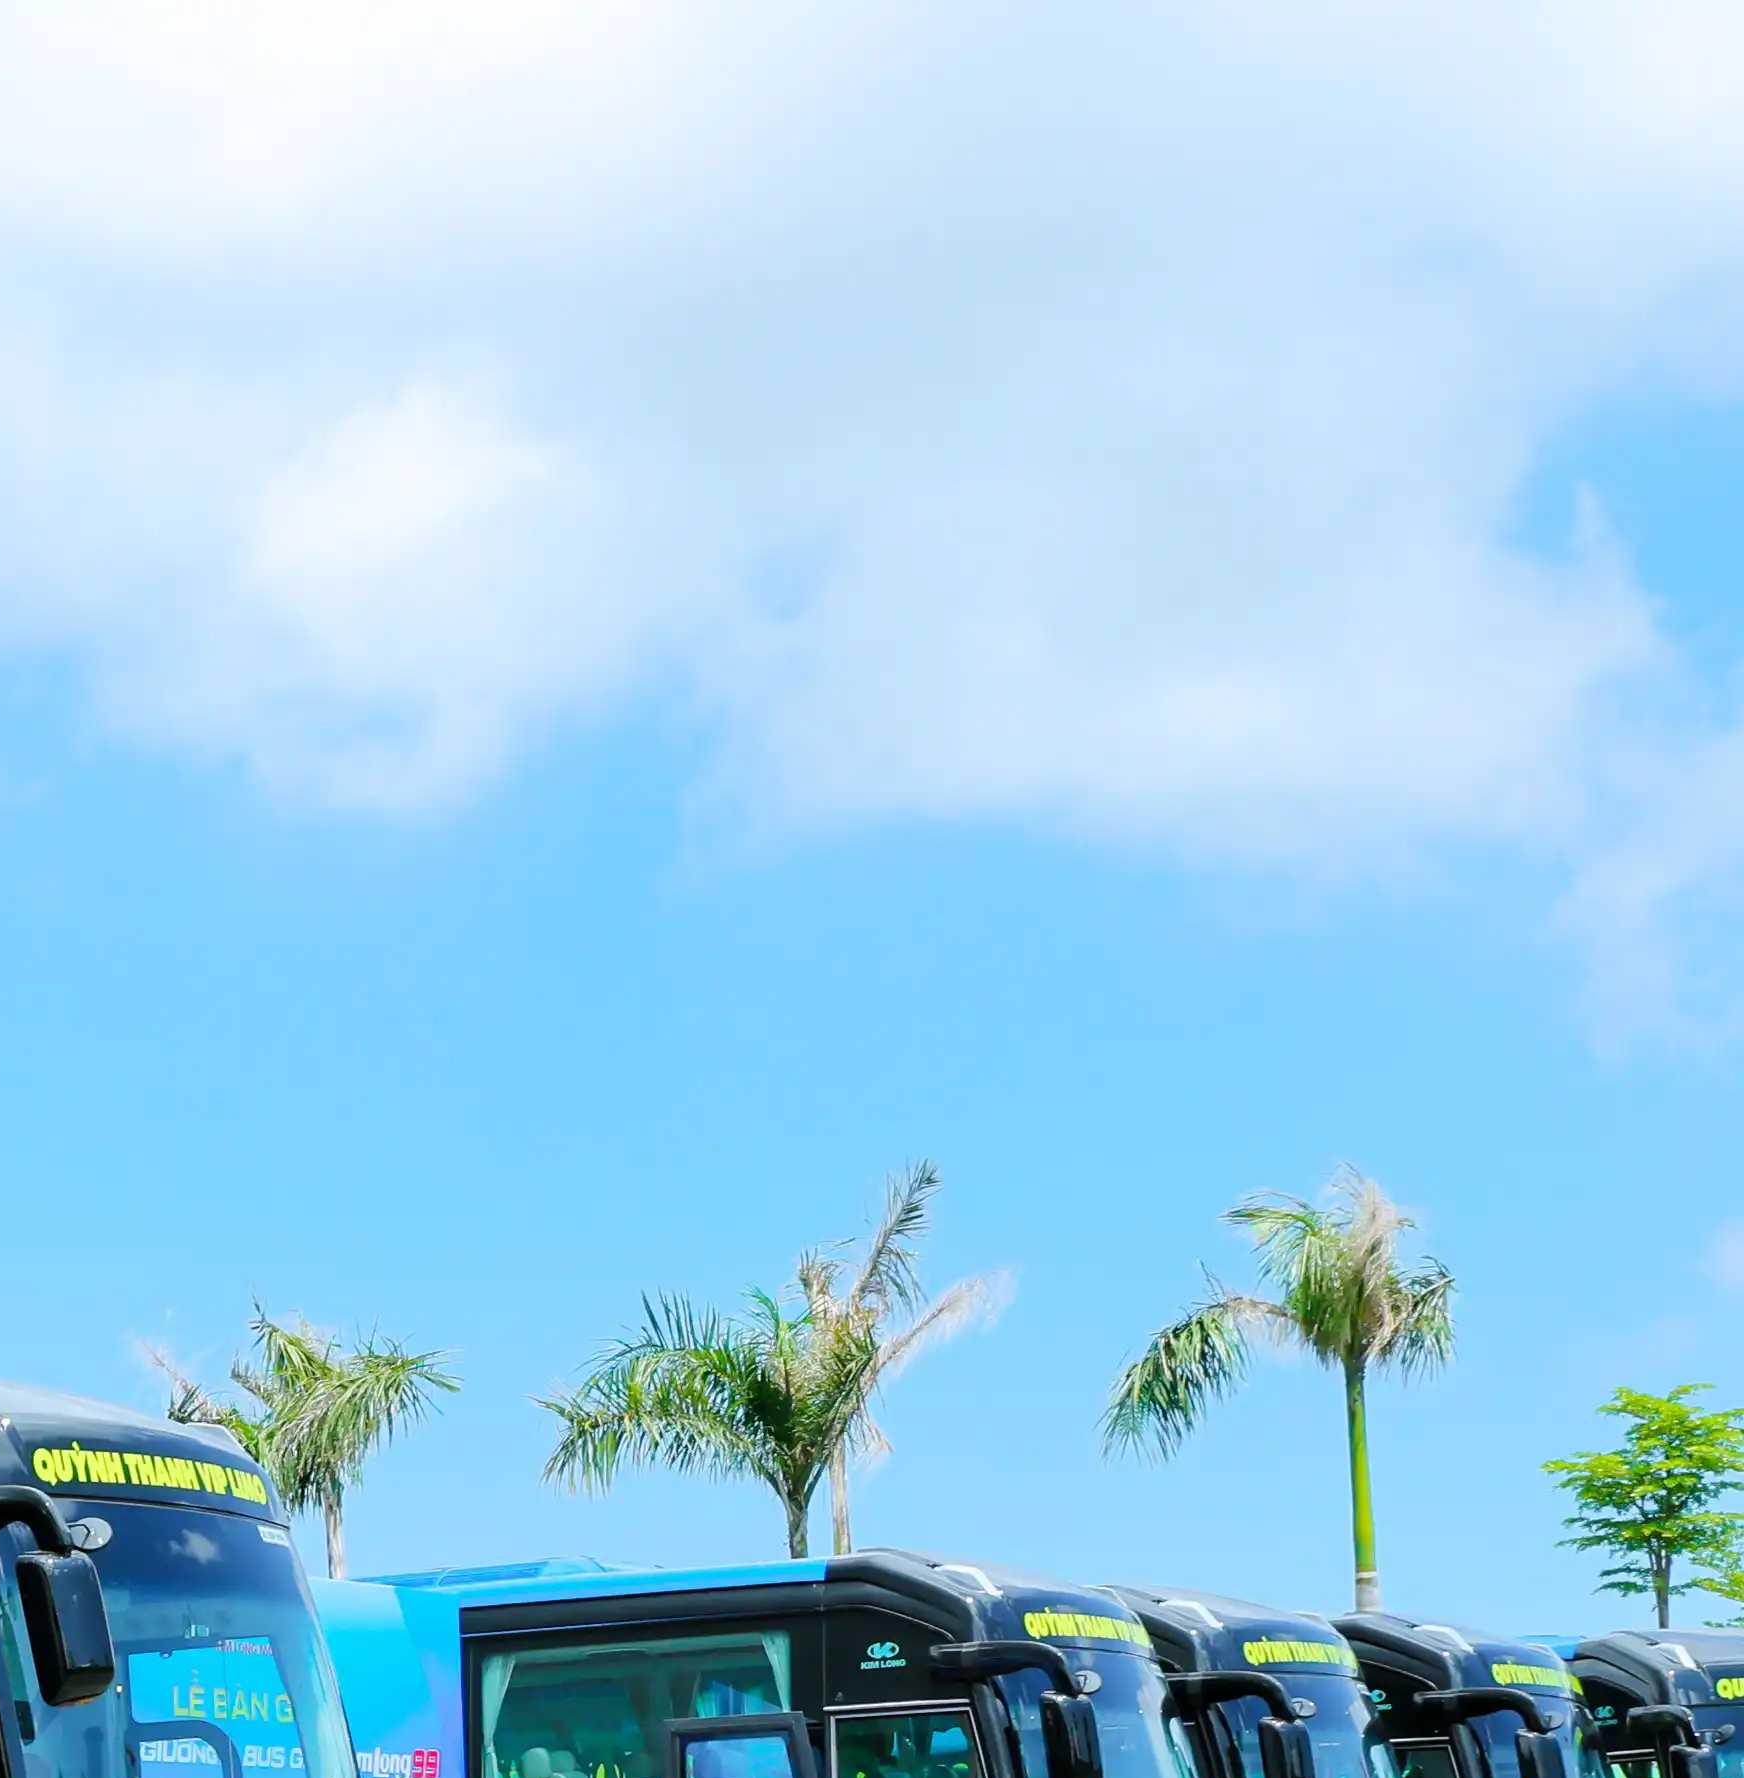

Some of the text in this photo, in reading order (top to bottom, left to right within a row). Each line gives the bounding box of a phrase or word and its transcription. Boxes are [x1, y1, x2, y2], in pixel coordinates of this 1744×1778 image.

[33, 1441, 268, 1505] QUỲNH THANH VIP LIMO
[243, 1744, 285, 1769] BUS
